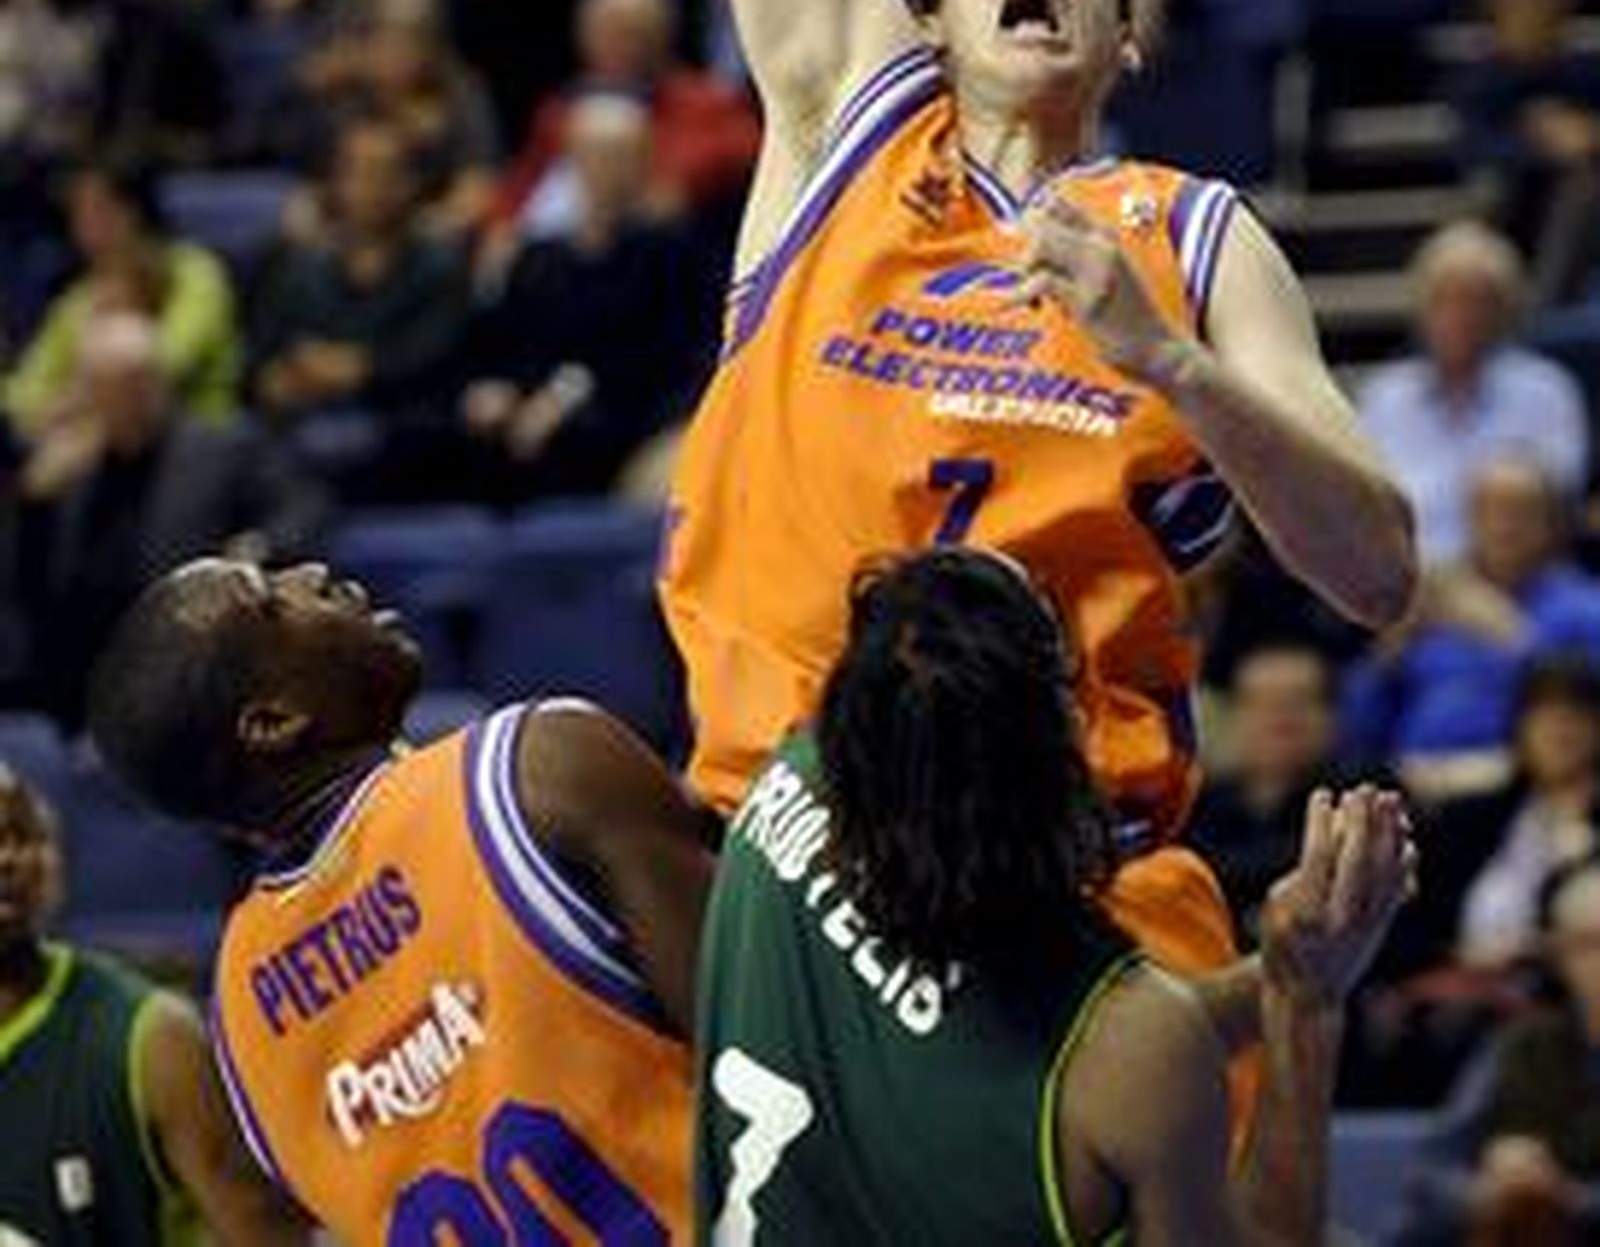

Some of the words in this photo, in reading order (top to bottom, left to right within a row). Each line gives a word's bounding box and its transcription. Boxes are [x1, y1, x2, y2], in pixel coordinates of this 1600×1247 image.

[821, 335, 1135, 418] ELECTRONICS
[873, 307, 1041, 359] POWER
[929, 459, 993, 546] 7
[250, 865, 422, 1036] PIETRUS
[326, 981, 485, 1147] PRIMA
